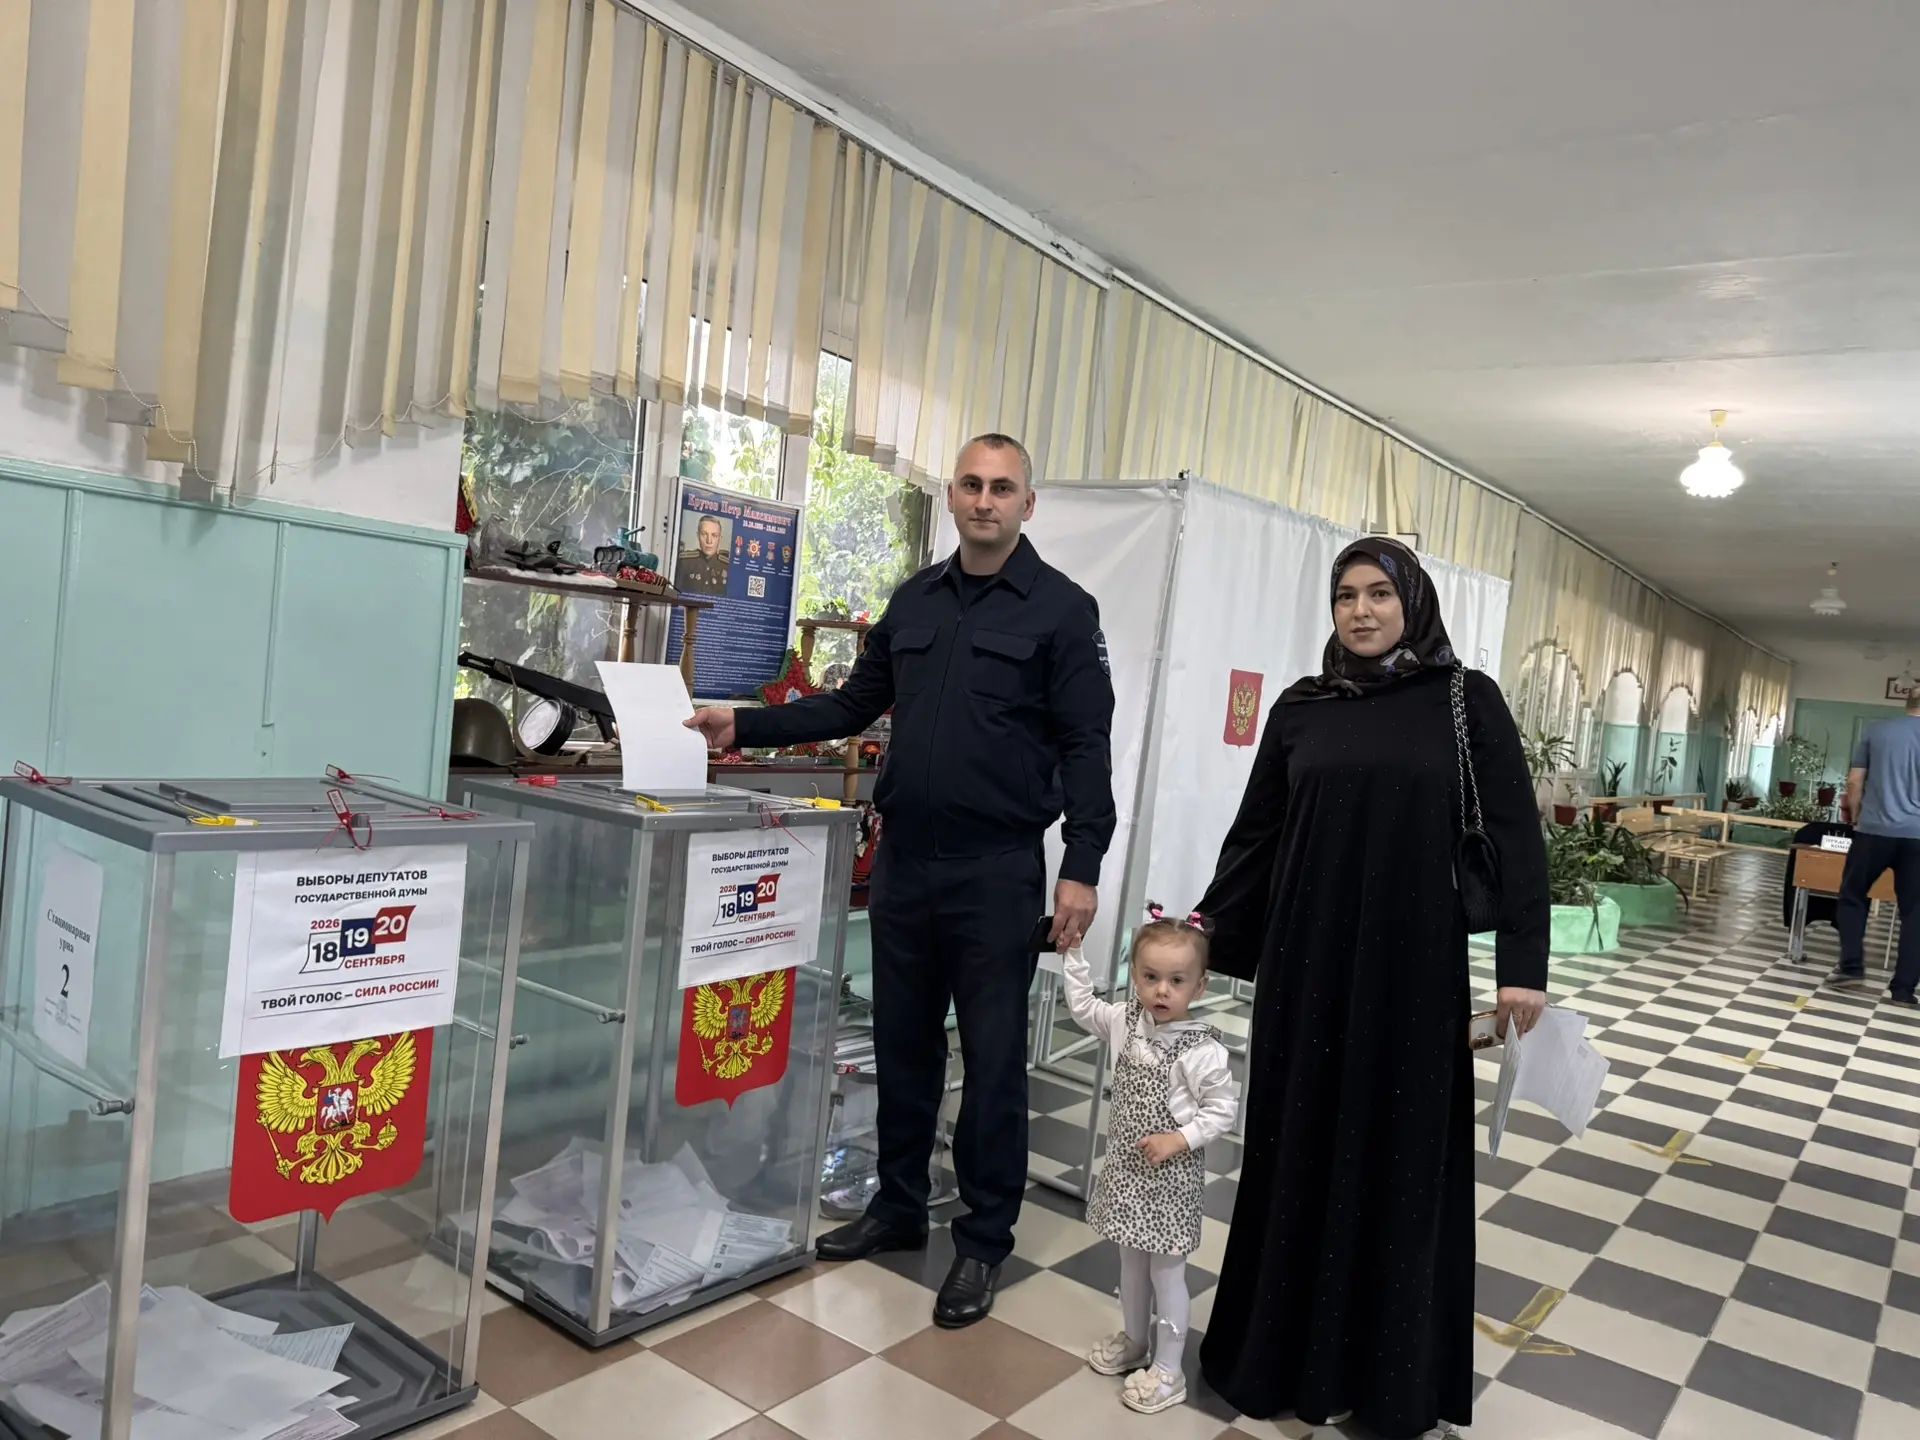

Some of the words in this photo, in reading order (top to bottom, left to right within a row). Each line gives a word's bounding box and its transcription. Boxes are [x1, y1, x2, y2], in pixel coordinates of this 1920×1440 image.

[712, 850, 746, 862] ВЫБОРЫ
[747, 847, 789, 859] ДЕПУТАТОВ
[711, 861, 771, 874] ГОСУДАРСТВЕННОЙ
[771, 860, 789, 868] ДУМЫ
[296, 874, 354, 887] ВЫБОРЫ
[356, 870, 428, 885] ДЕПУТАТОВ
[294, 887, 397, 904] ГОСУДАРСТВЕННОЙ
[398, 887, 428, 899] ДУМЫ
[719, 884, 737, 893] 2026
[720, 903, 736, 919] 18
[738, 892, 755, 907] 19
[757, 882, 776, 898] 20
[47, 907, 91, 944] Стационарная
[310, 918, 340, 930] 2026
[738, 911, 776, 923] СЕНТЯБРЯ
[59, 936, 74, 953] урна
[311, 941, 338, 963] 18
[344, 927, 369, 948] 19
[374, 914, 405, 936] 20
[691, 942, 712, 954] ТВОЙ
[713, 940, 738, 950] ГОЛОС
[745, 935, 764, 944] СИЛА
[765, 930, 796, 941] РОССИИ!
[344, 954, 405, 969] СЕНТЯБРЯ
[60, 964, 70, 998] 2
[261, 994, 297, 1010] ТВОЙ
[299, 991, 342, 1005] ГОЛОС
[354, 985, 387, 998] СИЛА
[389, 979, 439, 994] РОССИИ!
